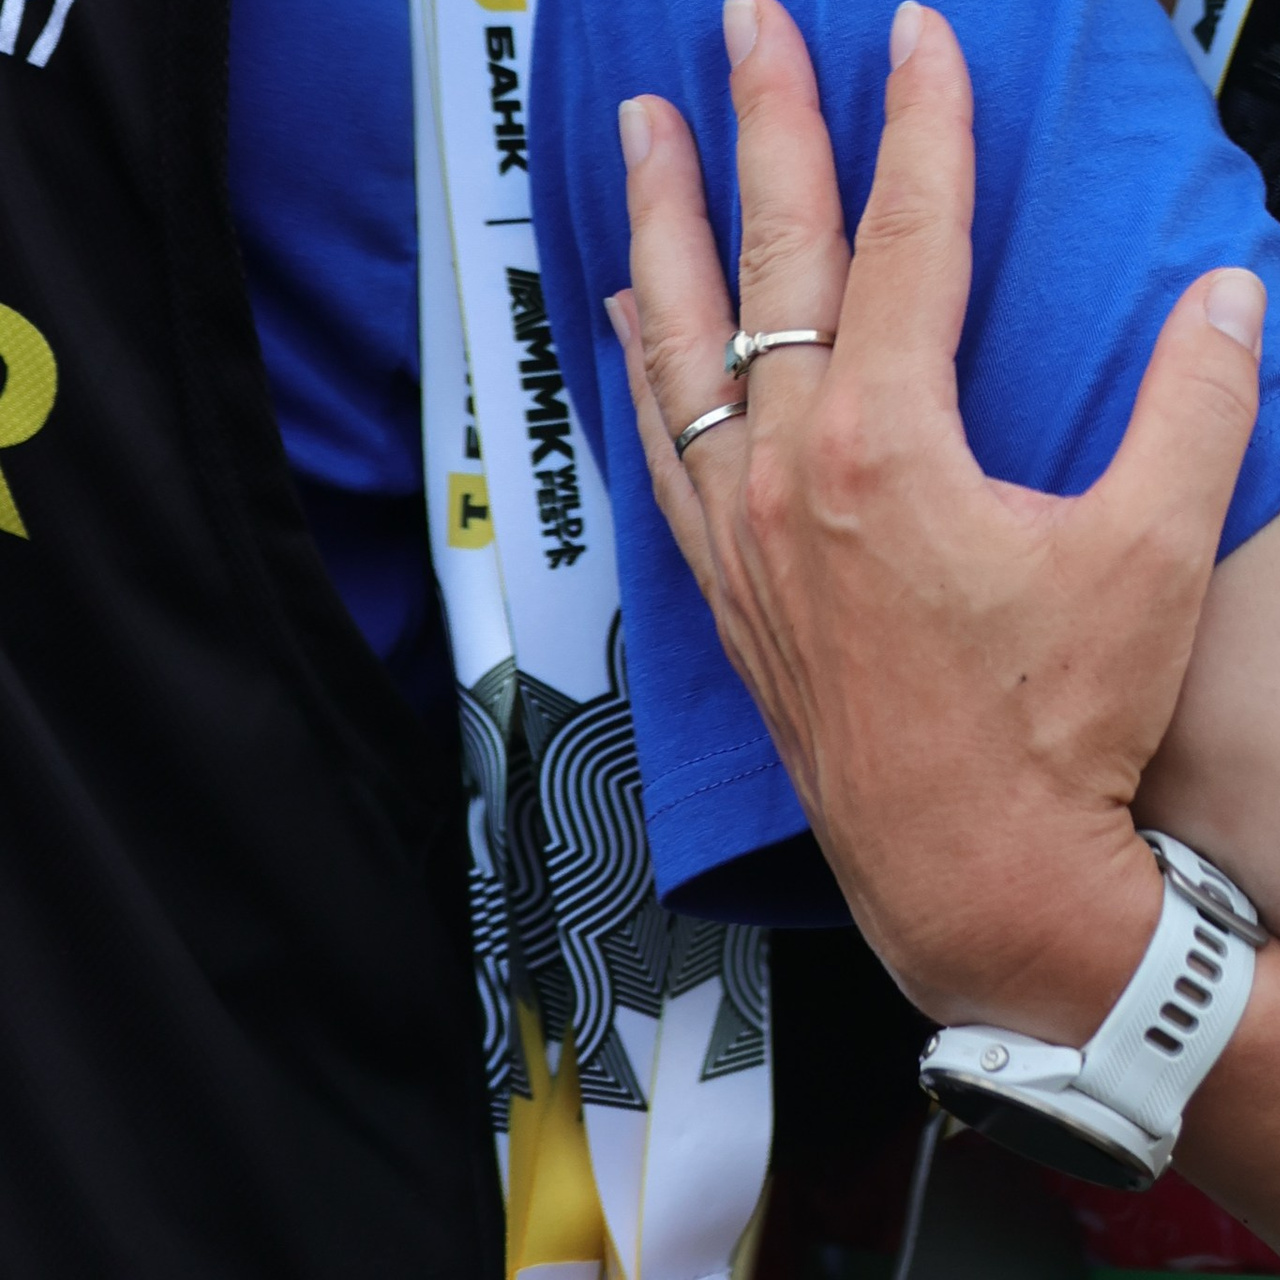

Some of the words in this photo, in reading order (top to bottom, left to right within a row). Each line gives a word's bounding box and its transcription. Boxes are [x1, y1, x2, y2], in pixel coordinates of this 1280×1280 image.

[485, 26, 529, 176] БАНК
[514, 324, 575, 468] MMK
[534, 470, 562, 540] FEST
[555, 463, 586, 539] WILD
